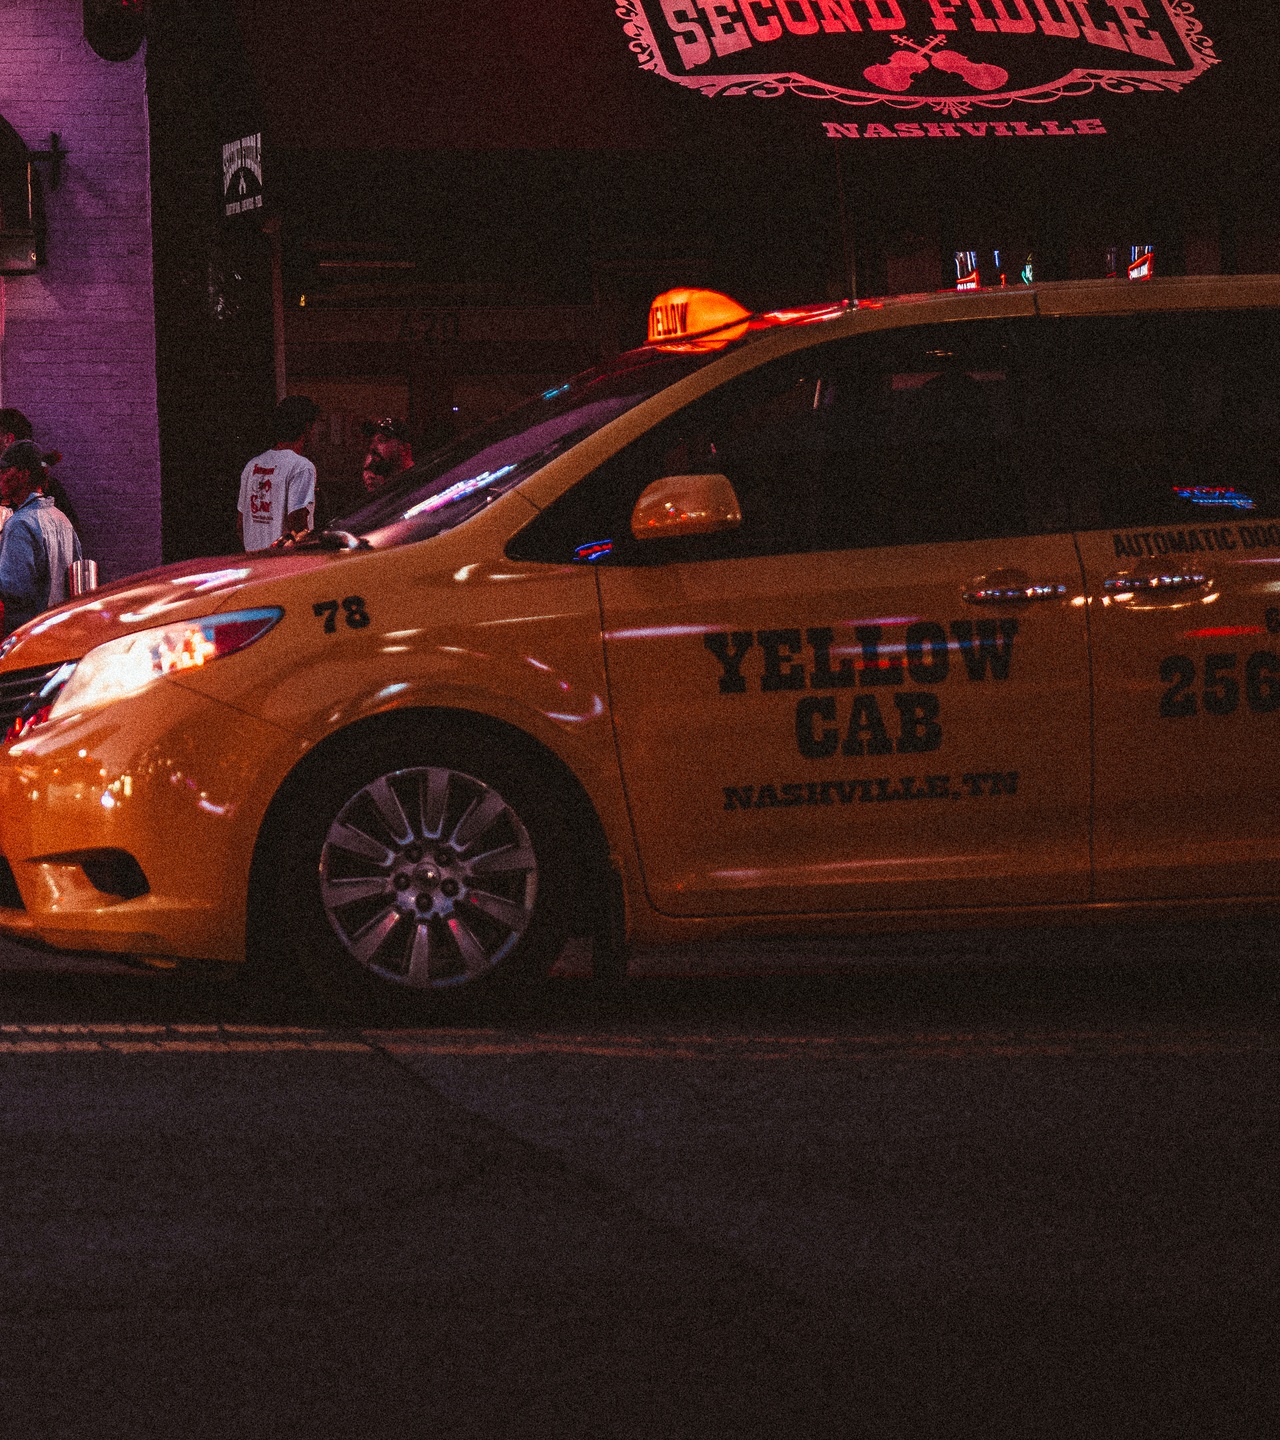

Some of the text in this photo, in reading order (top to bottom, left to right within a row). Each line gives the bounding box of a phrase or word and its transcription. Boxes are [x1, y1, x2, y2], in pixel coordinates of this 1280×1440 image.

[822, 118, 1107, 139] NASHVILLE
[1113, 527, 1237, 558] AUTOMATIC
[311, 595, 371, 634] 78
[704, 618, 1020, 694] YELLOW
[1159, 650, 1280, 719] 256
[795, 691, 942, 759] CAB
